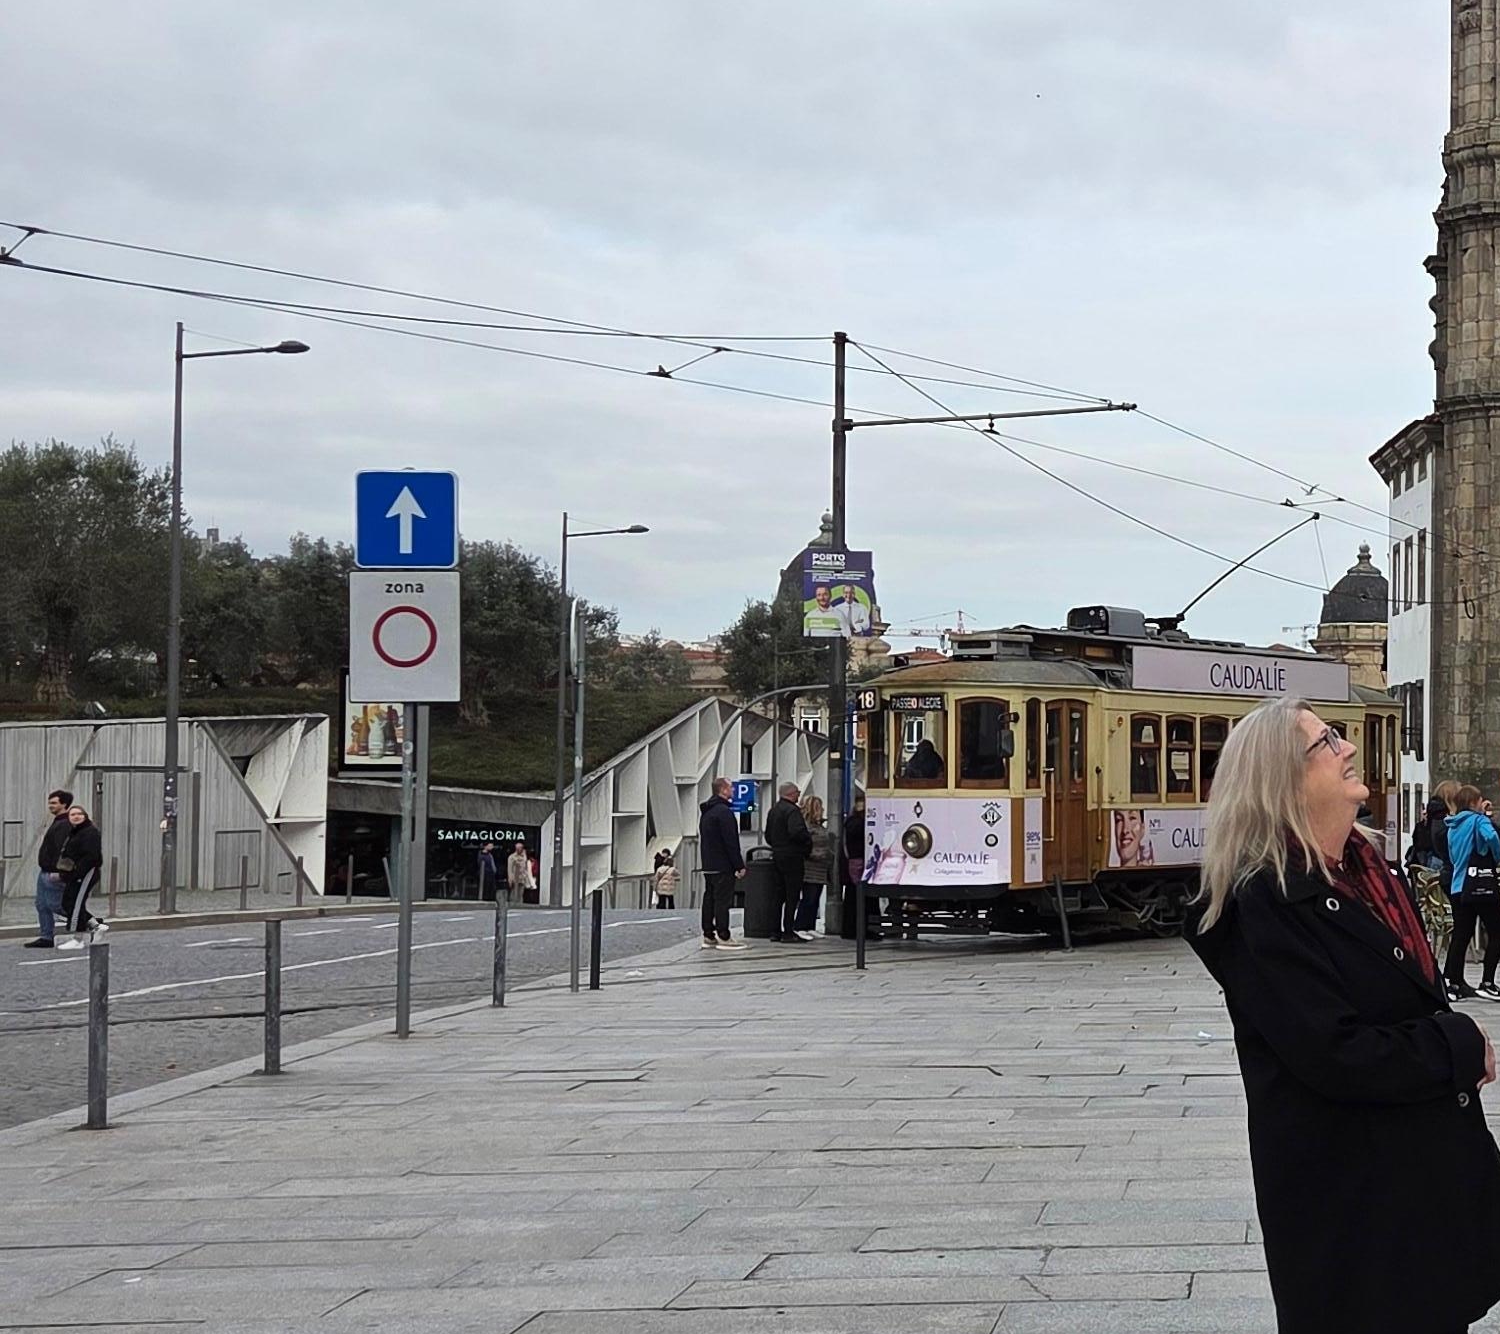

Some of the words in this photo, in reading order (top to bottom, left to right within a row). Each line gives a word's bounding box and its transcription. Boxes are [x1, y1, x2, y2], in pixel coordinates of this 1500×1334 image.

[812, 553, 846, 561] PORTO
[385, 583, 425, 594] zona
[1210, 661, 1287, 692] CAUDALÍE
[858, 691, 875, 709] 18
[437, 829, 526, 841] SANTAGLORIA
[1171, 827, 1207, 849] CAUD
[933, 850, 990, 865] CAUDALÍE
